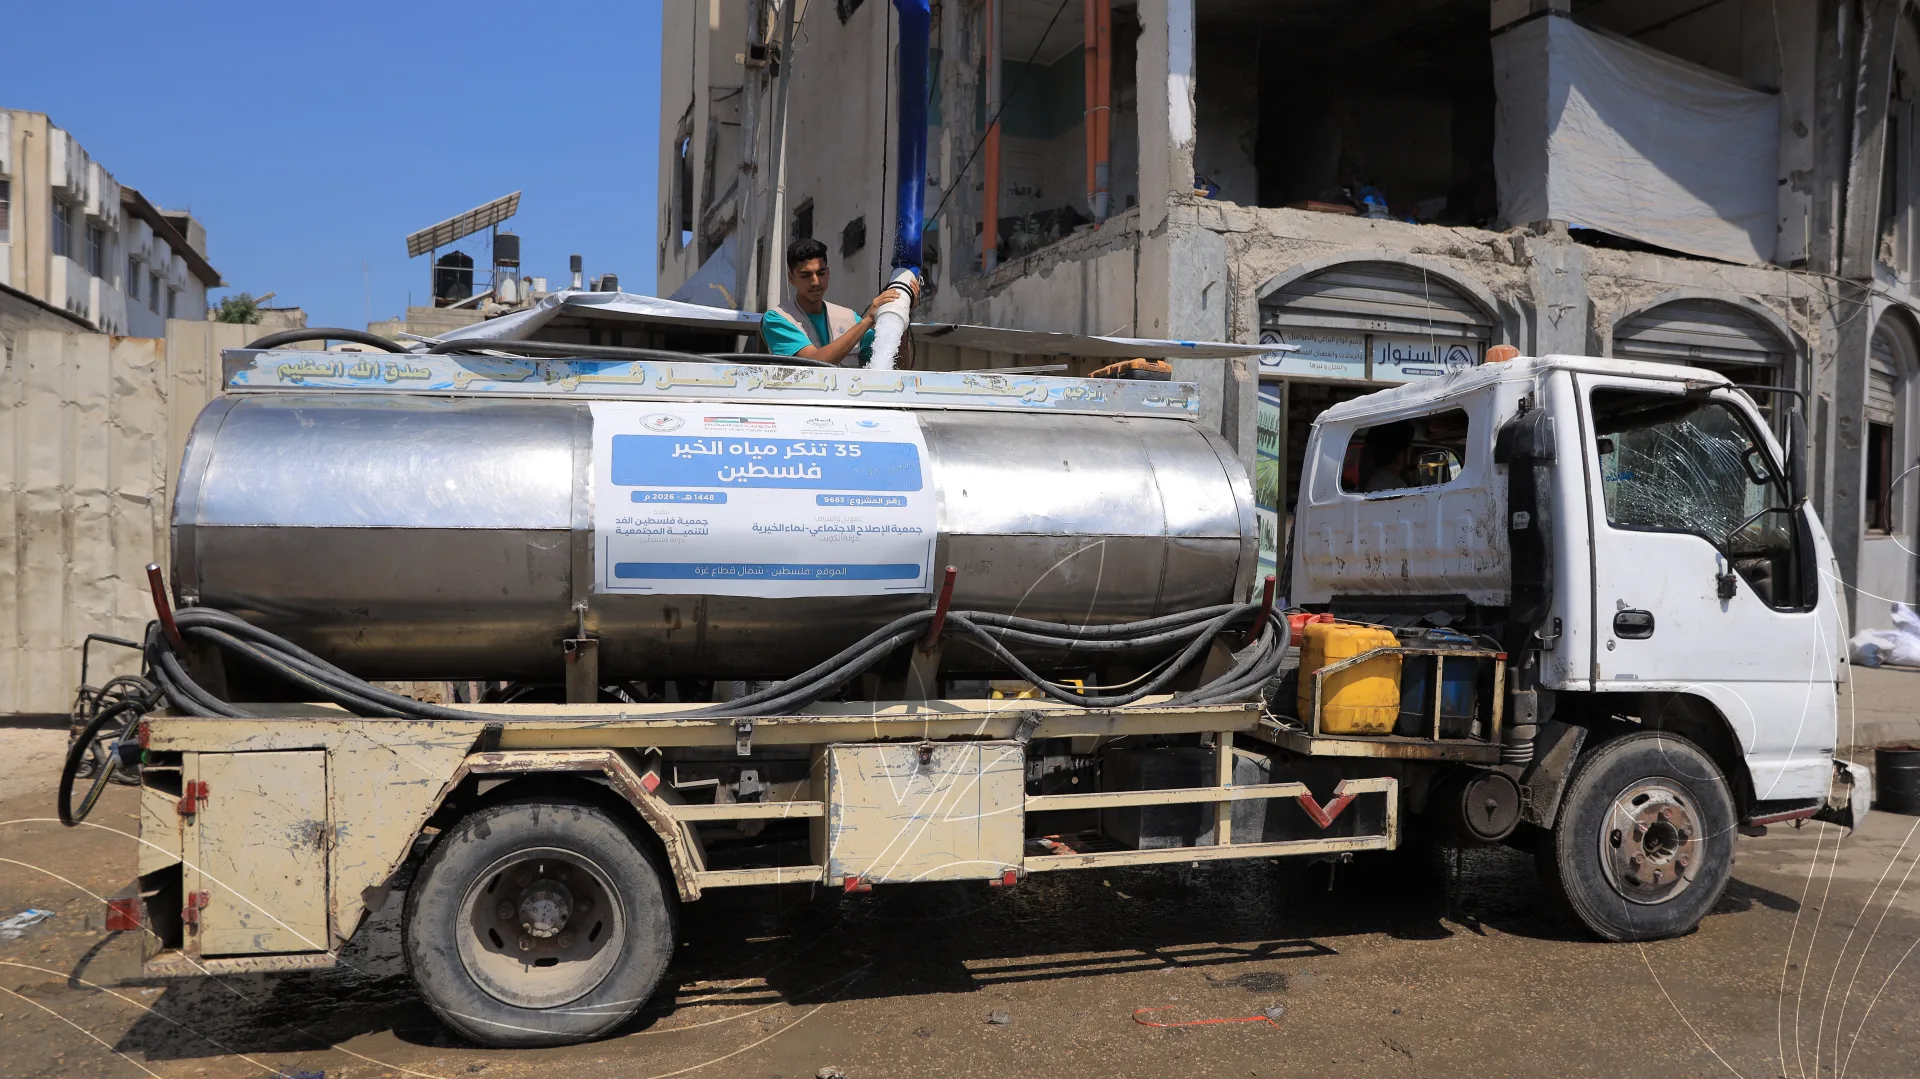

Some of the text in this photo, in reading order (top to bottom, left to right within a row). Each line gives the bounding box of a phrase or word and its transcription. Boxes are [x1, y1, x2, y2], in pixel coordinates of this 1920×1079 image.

[1378, 342, 1441, 365] السنوار
[277, 359, 344, 383] العظيم
[348, 357, 379, 379] الله
[384, 361, 432, 383] صدق
[655, 366, 737, 390] كل
[847, 375, 904, 396] من
[915, 375, 1049, 402] وجا
[672, 439, 862, 460] 35 تنكر مياه الخير
[717, 462, 822, 483] فلسطين
[847, 495, 883, 506] المشروع:
[885, 496, 901, 506] رقم
[635, 517, 676, 526] فلسطين
[677, 517, 709, 526] جمعية
[616, 526, 665, 537] المجتمعية
[752, 522, 785, 534] الخيرية
[785, 523, 805, 532] نماء
[856, 524, 890, 536] الإصلاح
[891, 524, 923, 536] جمعية
[640, 536, 669, 544] فلسطين
[695, 566, 709, 576] غزة
[712, 566, 736, 577] قطاع
[737, 566, 764, 577] شمال
[771, 567, 810, 577] فلسطين
[815, 567, 847, 578] الموقع
